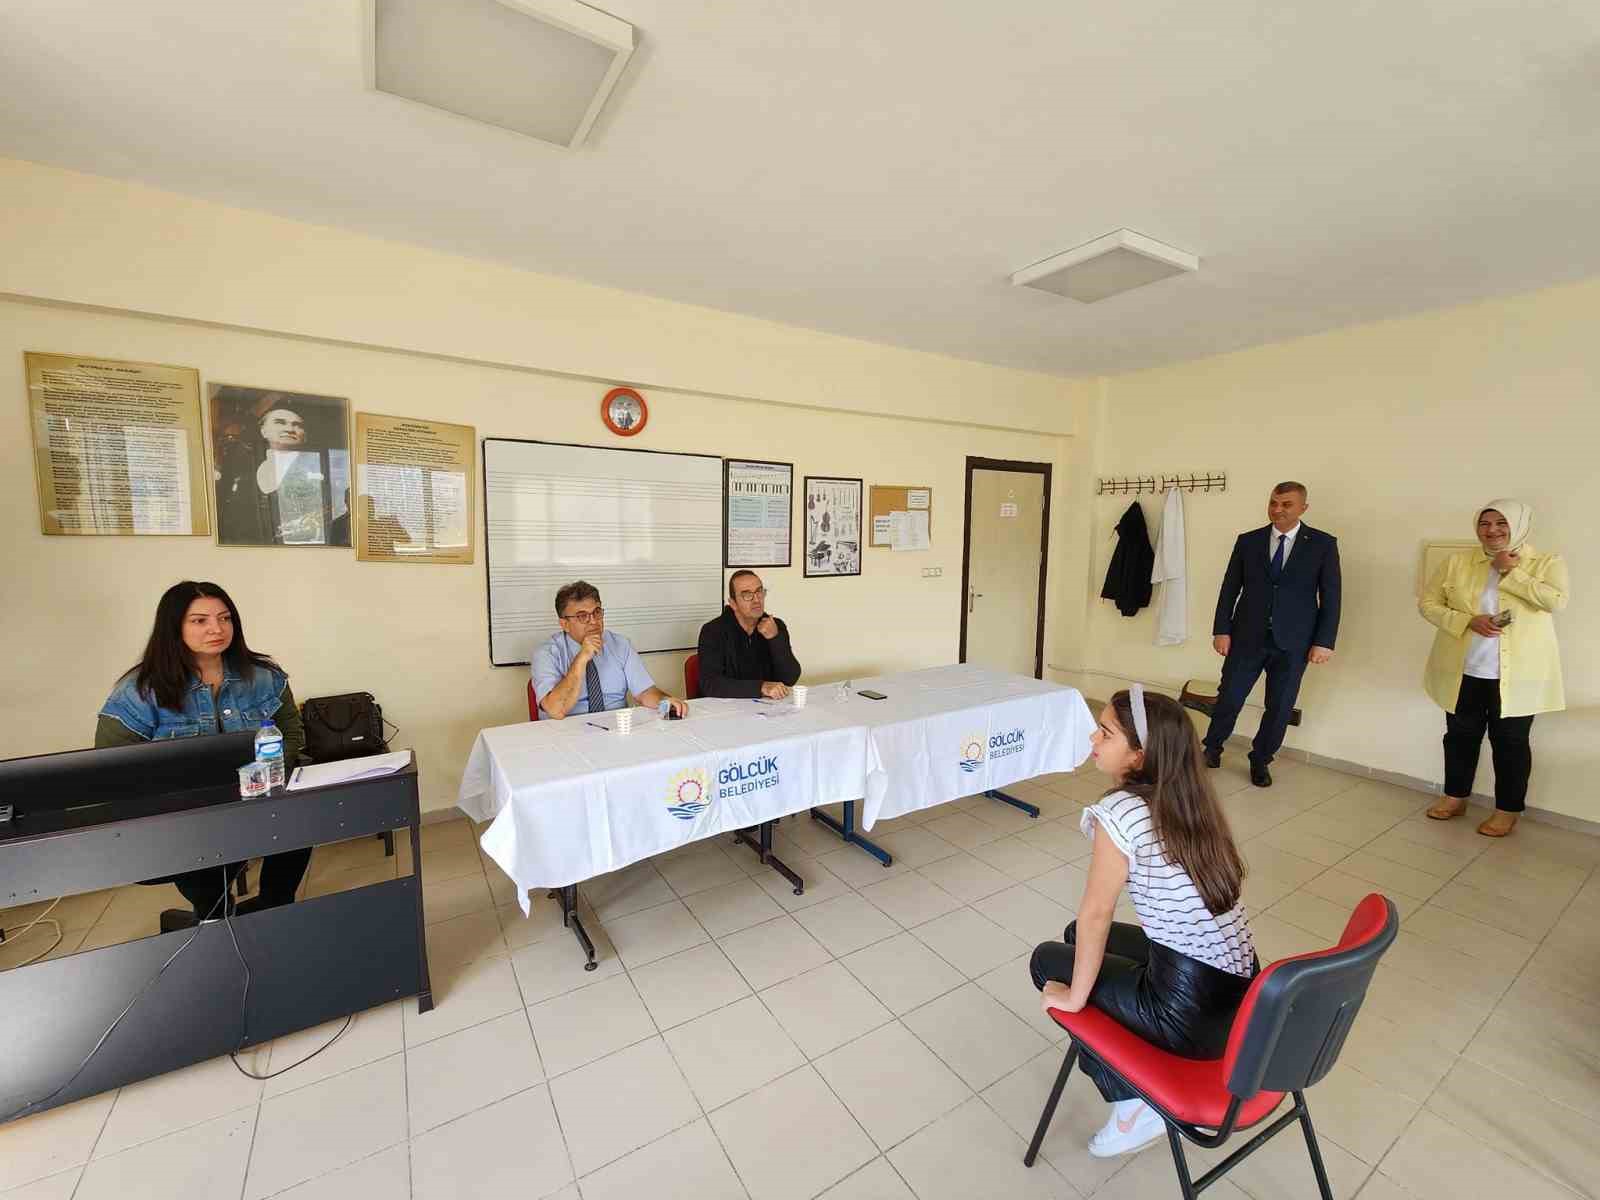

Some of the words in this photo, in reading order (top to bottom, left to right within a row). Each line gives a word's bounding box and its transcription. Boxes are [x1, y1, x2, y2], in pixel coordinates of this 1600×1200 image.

[989, 728, 1025, 748] GÖLCÜK
[718, 755, 778, 785] GÖLCÜK
[719, 773, 780, 799] BELEDİYESİ
